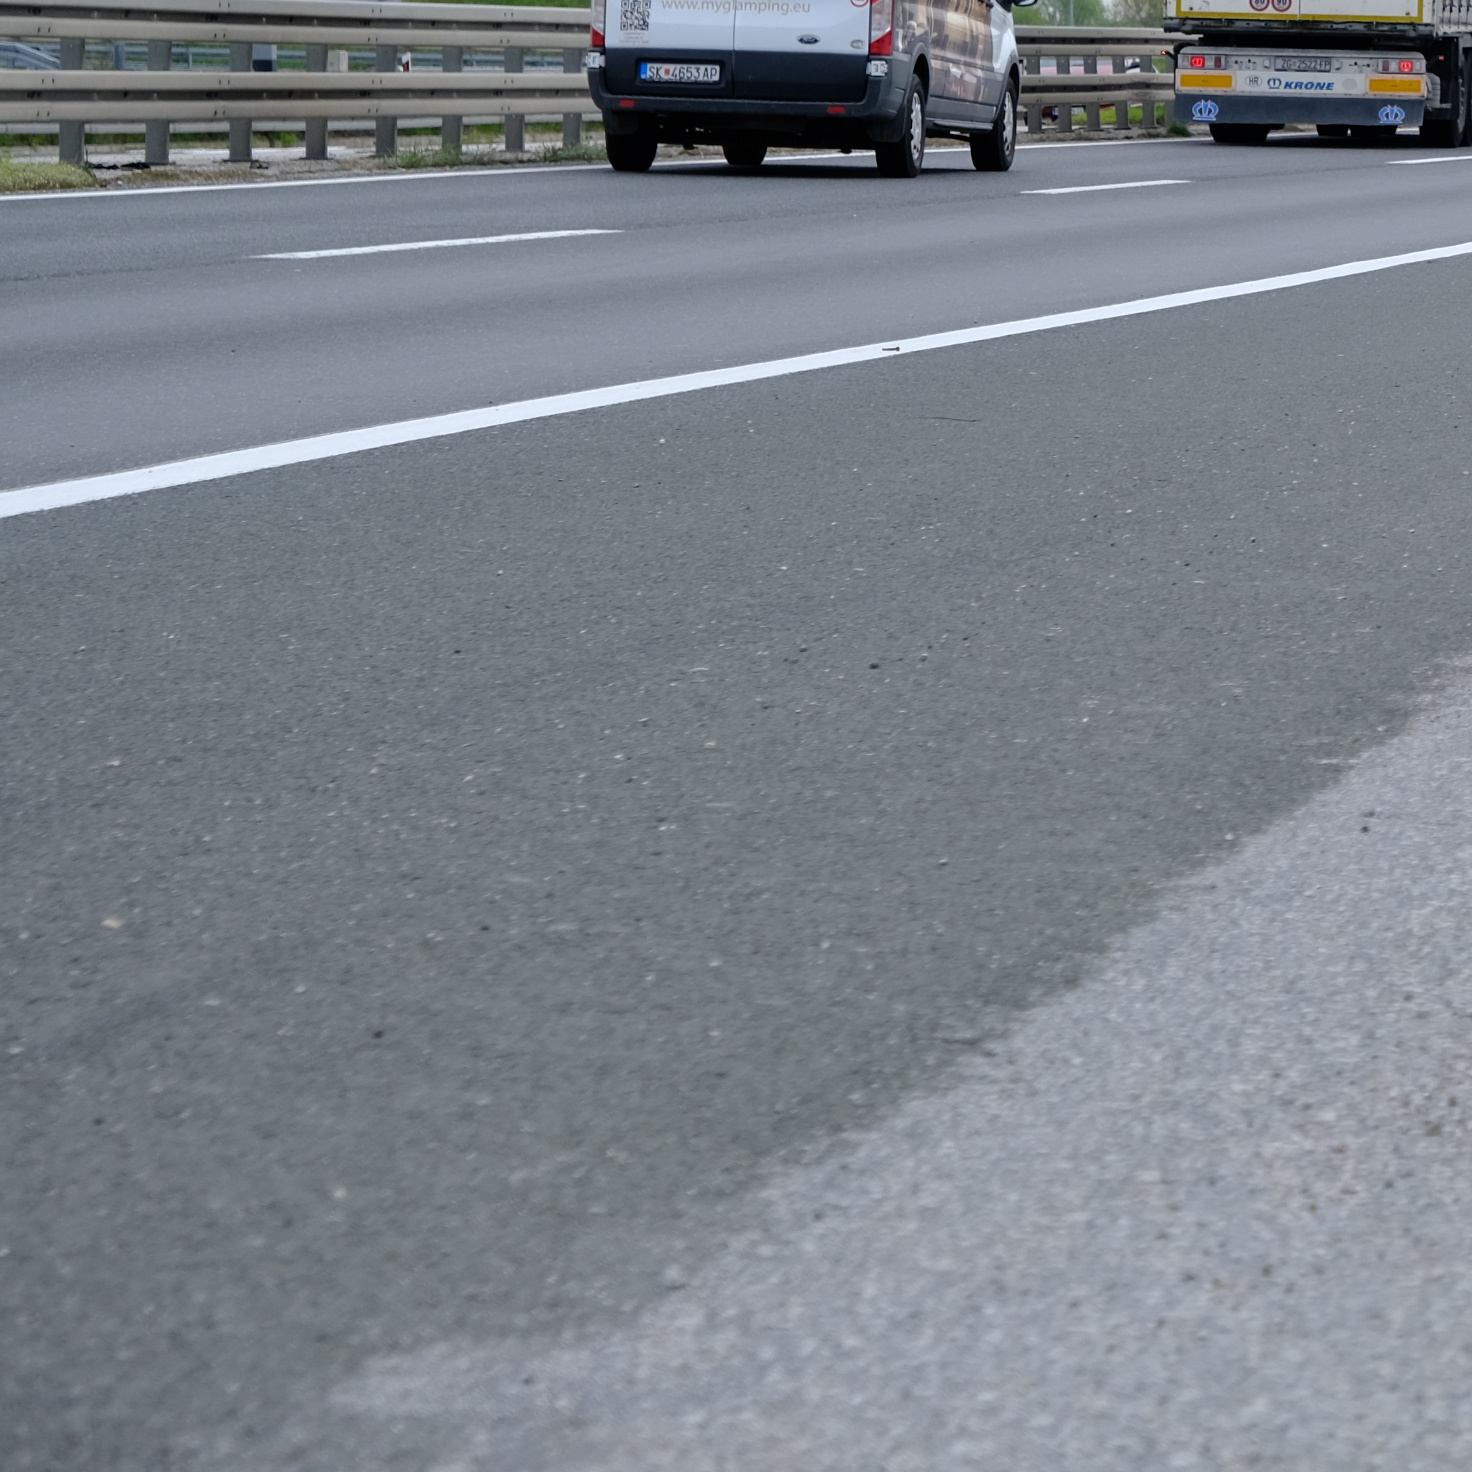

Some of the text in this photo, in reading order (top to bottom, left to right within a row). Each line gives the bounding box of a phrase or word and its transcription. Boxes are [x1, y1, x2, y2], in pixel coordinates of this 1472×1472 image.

[648, 65, 662, 79] SK
[1248, 77, 1335, 91] HR KRONE
